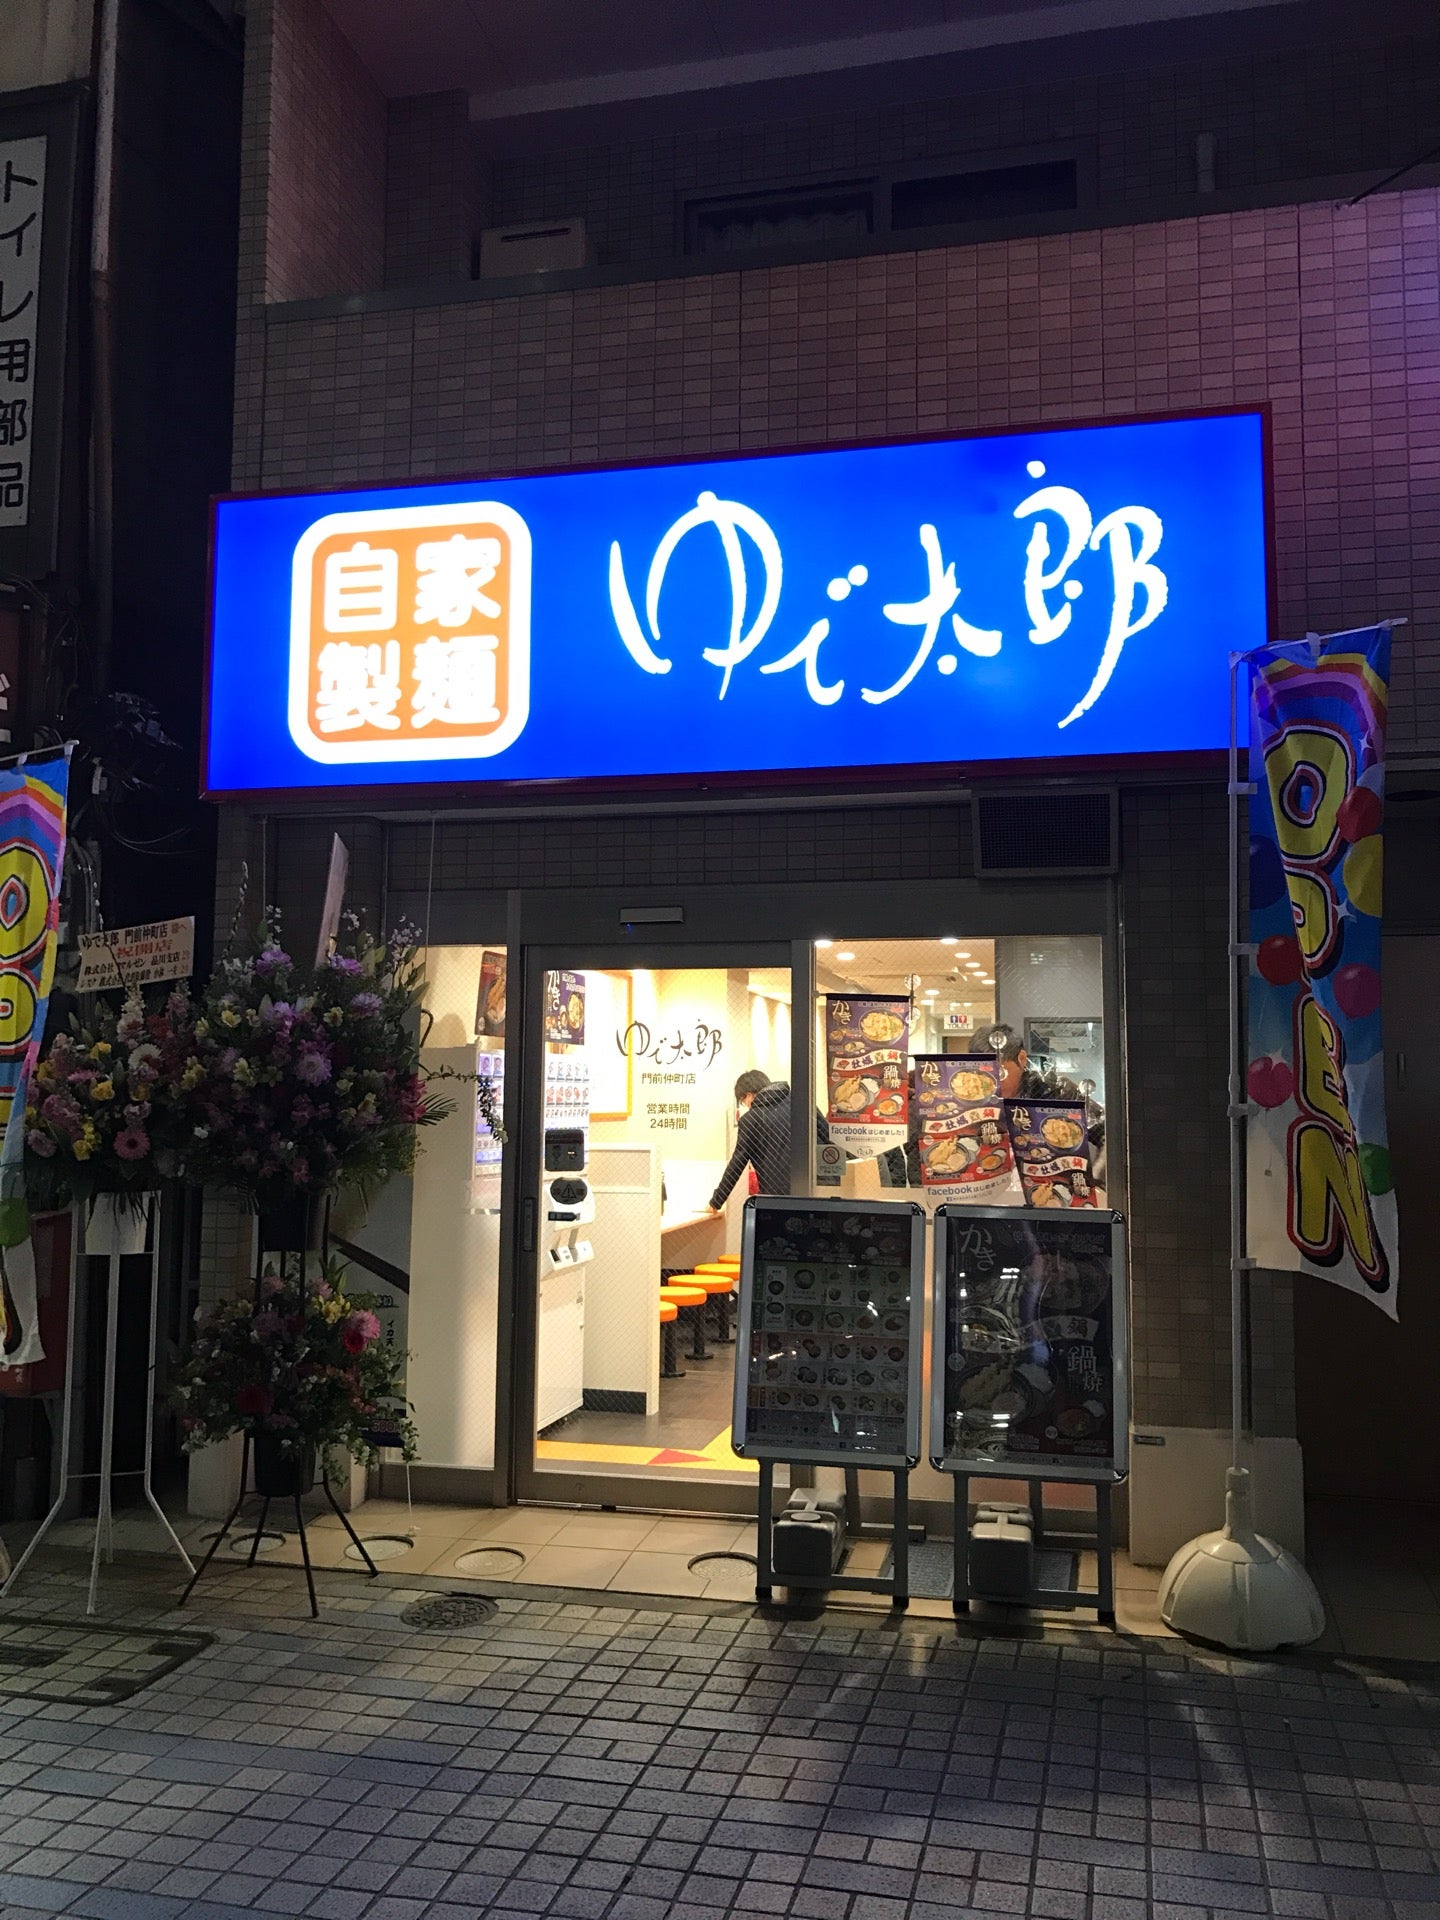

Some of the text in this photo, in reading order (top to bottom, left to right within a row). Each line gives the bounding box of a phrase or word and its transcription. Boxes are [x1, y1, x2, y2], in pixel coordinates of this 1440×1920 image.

[322, 533, 502, 628] 自家
[608, 459, 1169, 730] ゆで太郎
[831, 1000, 852, 1025] かき
[616, 1017, 723, 1071] ゆで太郎
[641, 1072, 697, 1085] 門前仲町店
[920, 1061, 942, 1087] かき
[646, 1102, 691, 1115] 営業時間
[1011, 1105, 1032, 1131] かき
[650, 1118, 688, 1130] 24時間
[831, 1125, 867, 1136] facebook
[927, 1184, 973, 1196] facebook
[959, 1223, 997, 1271] かき
[1066, 1344, 1104, 1393] 鍋焼
